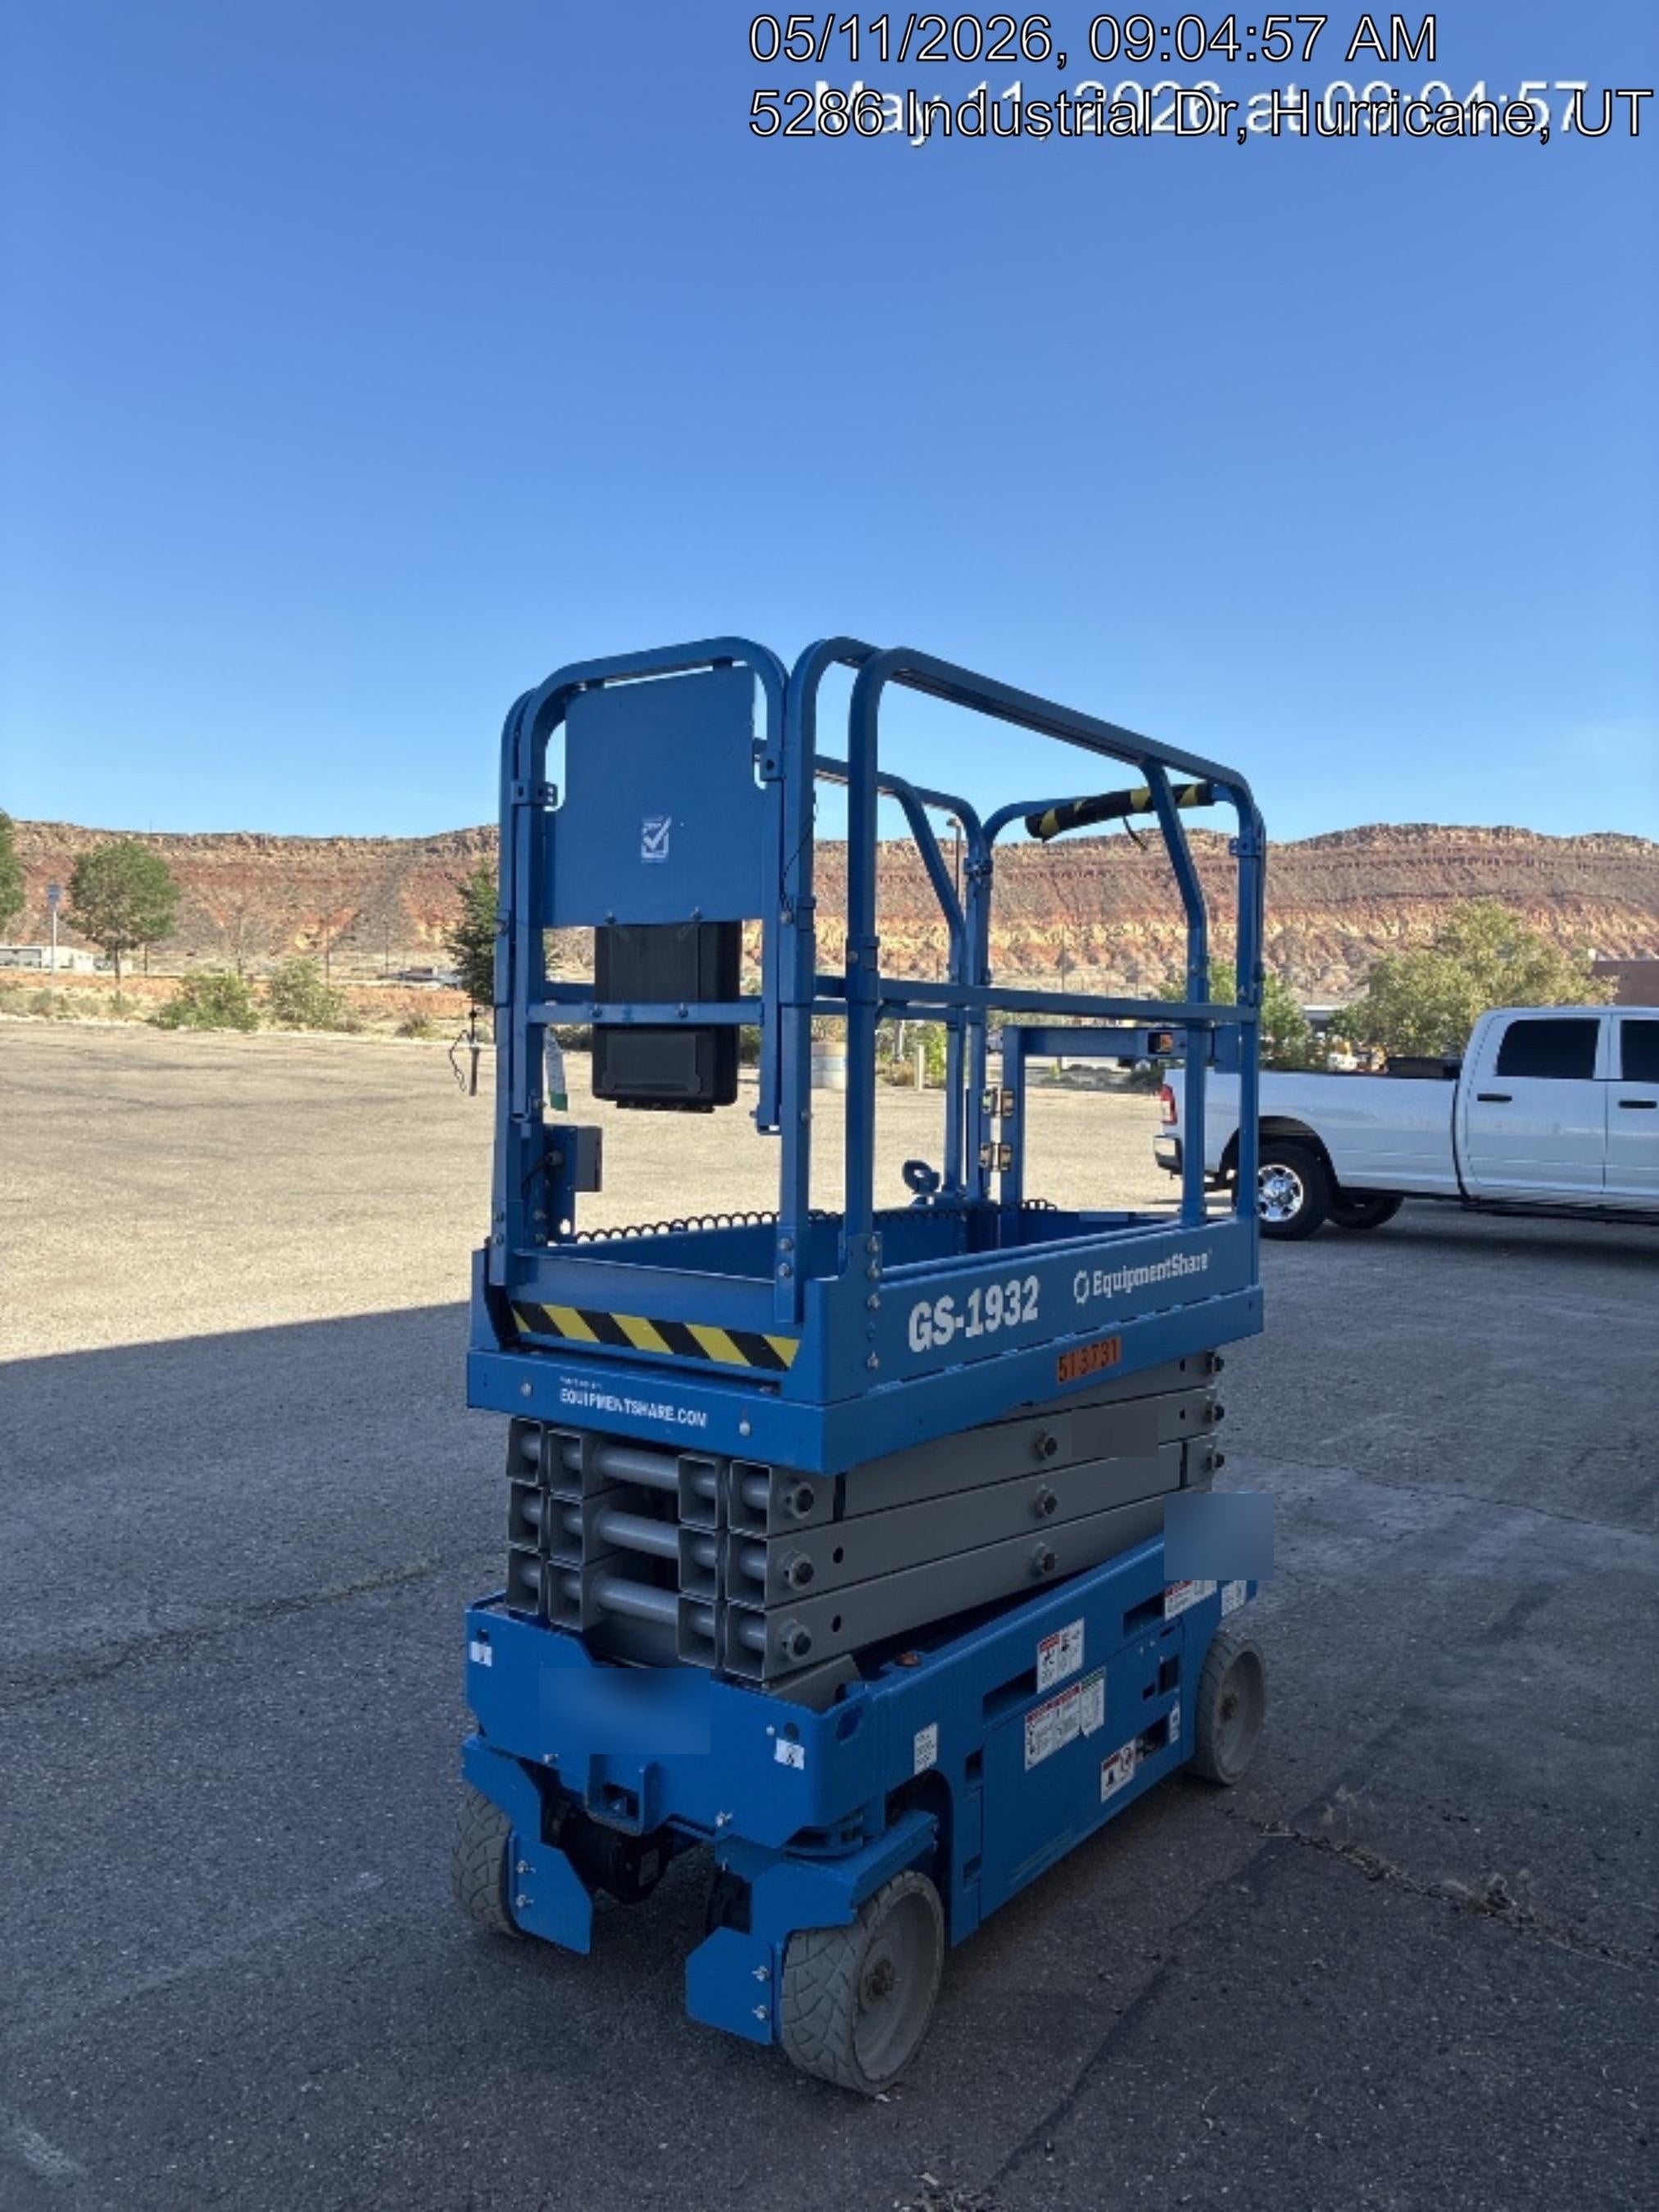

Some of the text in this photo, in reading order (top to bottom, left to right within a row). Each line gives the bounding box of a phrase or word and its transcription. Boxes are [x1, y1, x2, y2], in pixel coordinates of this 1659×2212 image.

[1093, 1253, 1208, 1299] EquipmentShare
[909, 1275, 1040, 1353] GS-1932
[560, 1388, 708, 1427] EQUIPMENTSHARE.COM
